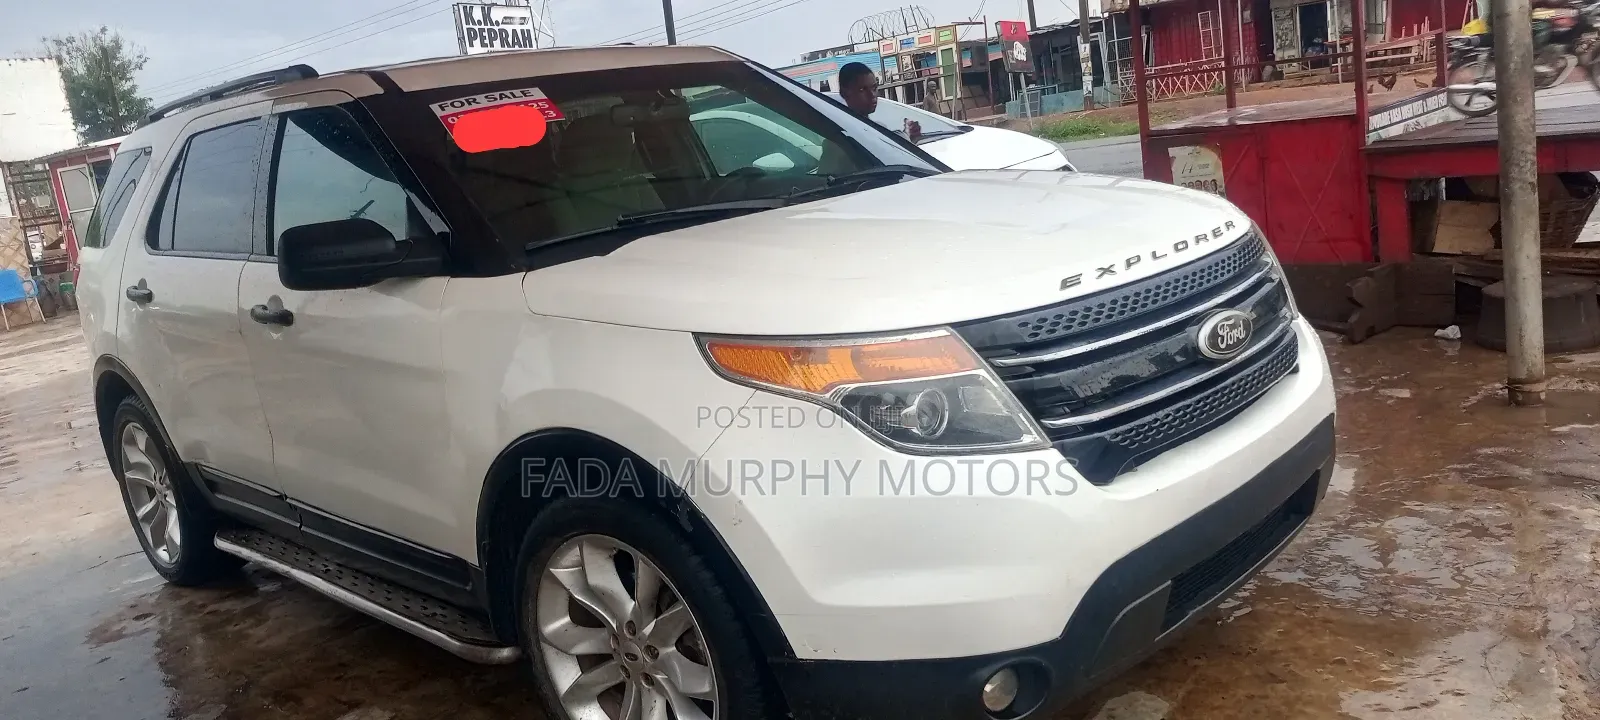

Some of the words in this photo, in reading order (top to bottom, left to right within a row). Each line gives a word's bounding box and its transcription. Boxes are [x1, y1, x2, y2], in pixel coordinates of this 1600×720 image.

[463, 6, 500, 27] K.K.
[466, 28, 533, 48] PEPRAH
[438, 97, 481, 111] FOR
[485, 89, 534, 102] SALE
[1059, 220, 1236, 291] EXPLORER
[1217, 318, 1246, 349] Ford
